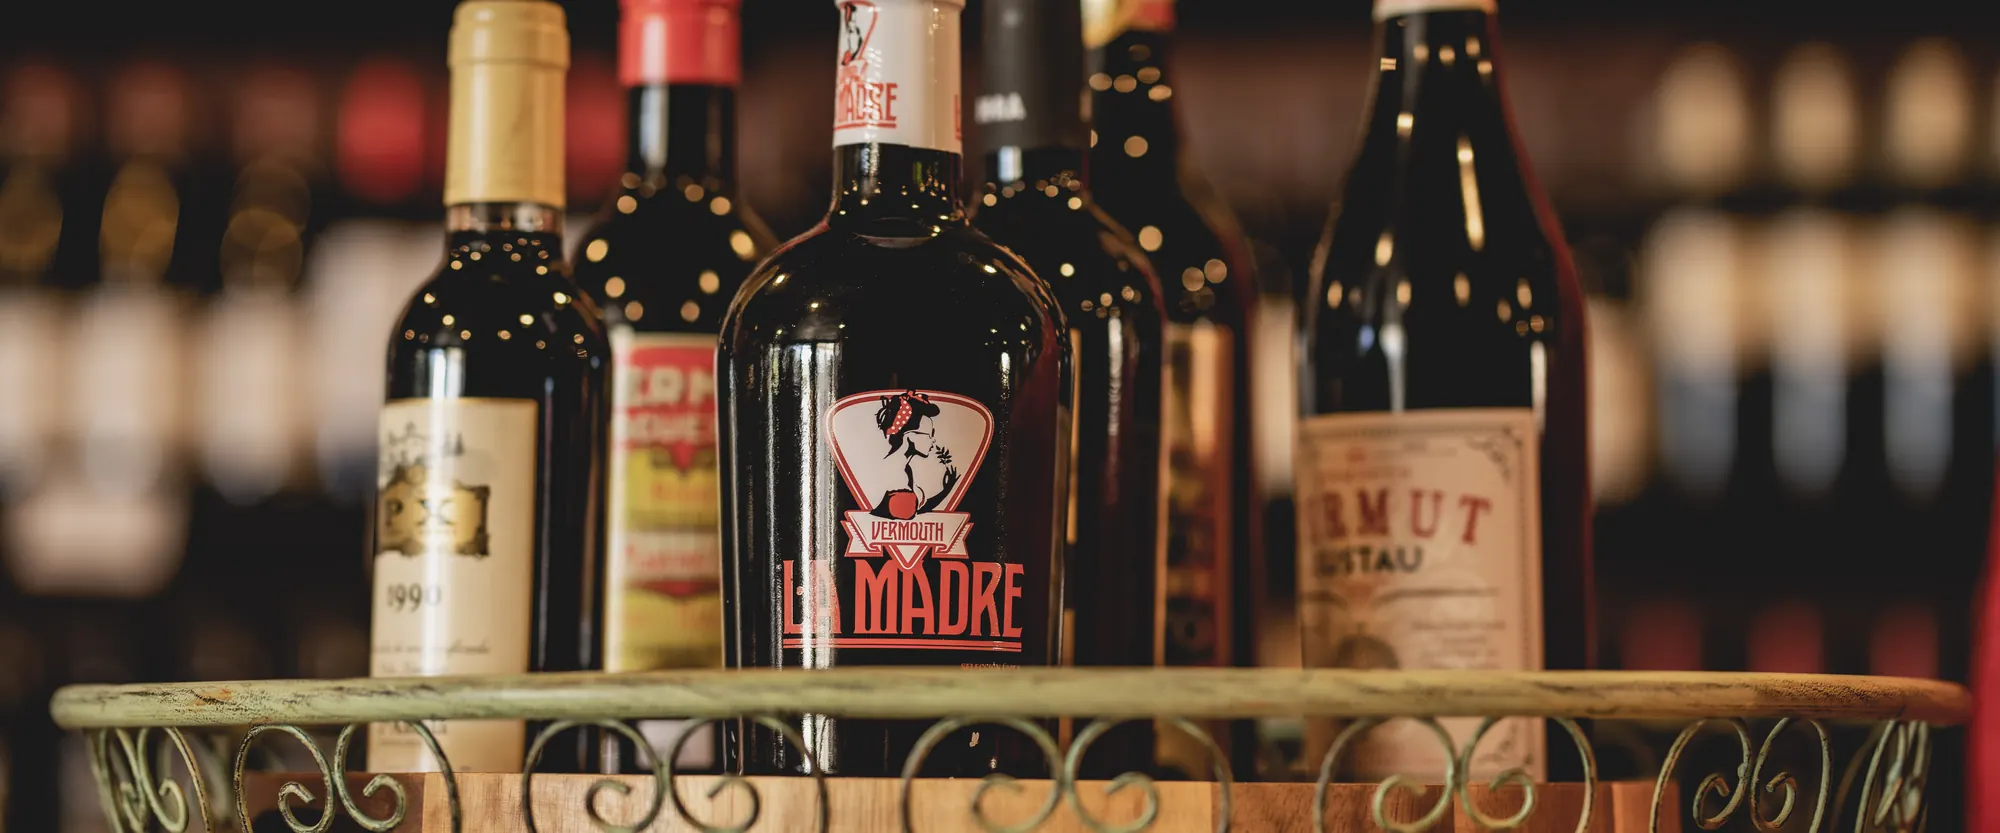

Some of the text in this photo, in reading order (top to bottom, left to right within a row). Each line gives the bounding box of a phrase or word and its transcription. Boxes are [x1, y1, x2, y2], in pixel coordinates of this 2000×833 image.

[872, 521, 944, 541] VERMOUTH
[387, 583, 441, 611] 1990
[783, 560, 1024, 637] LA MADRE
